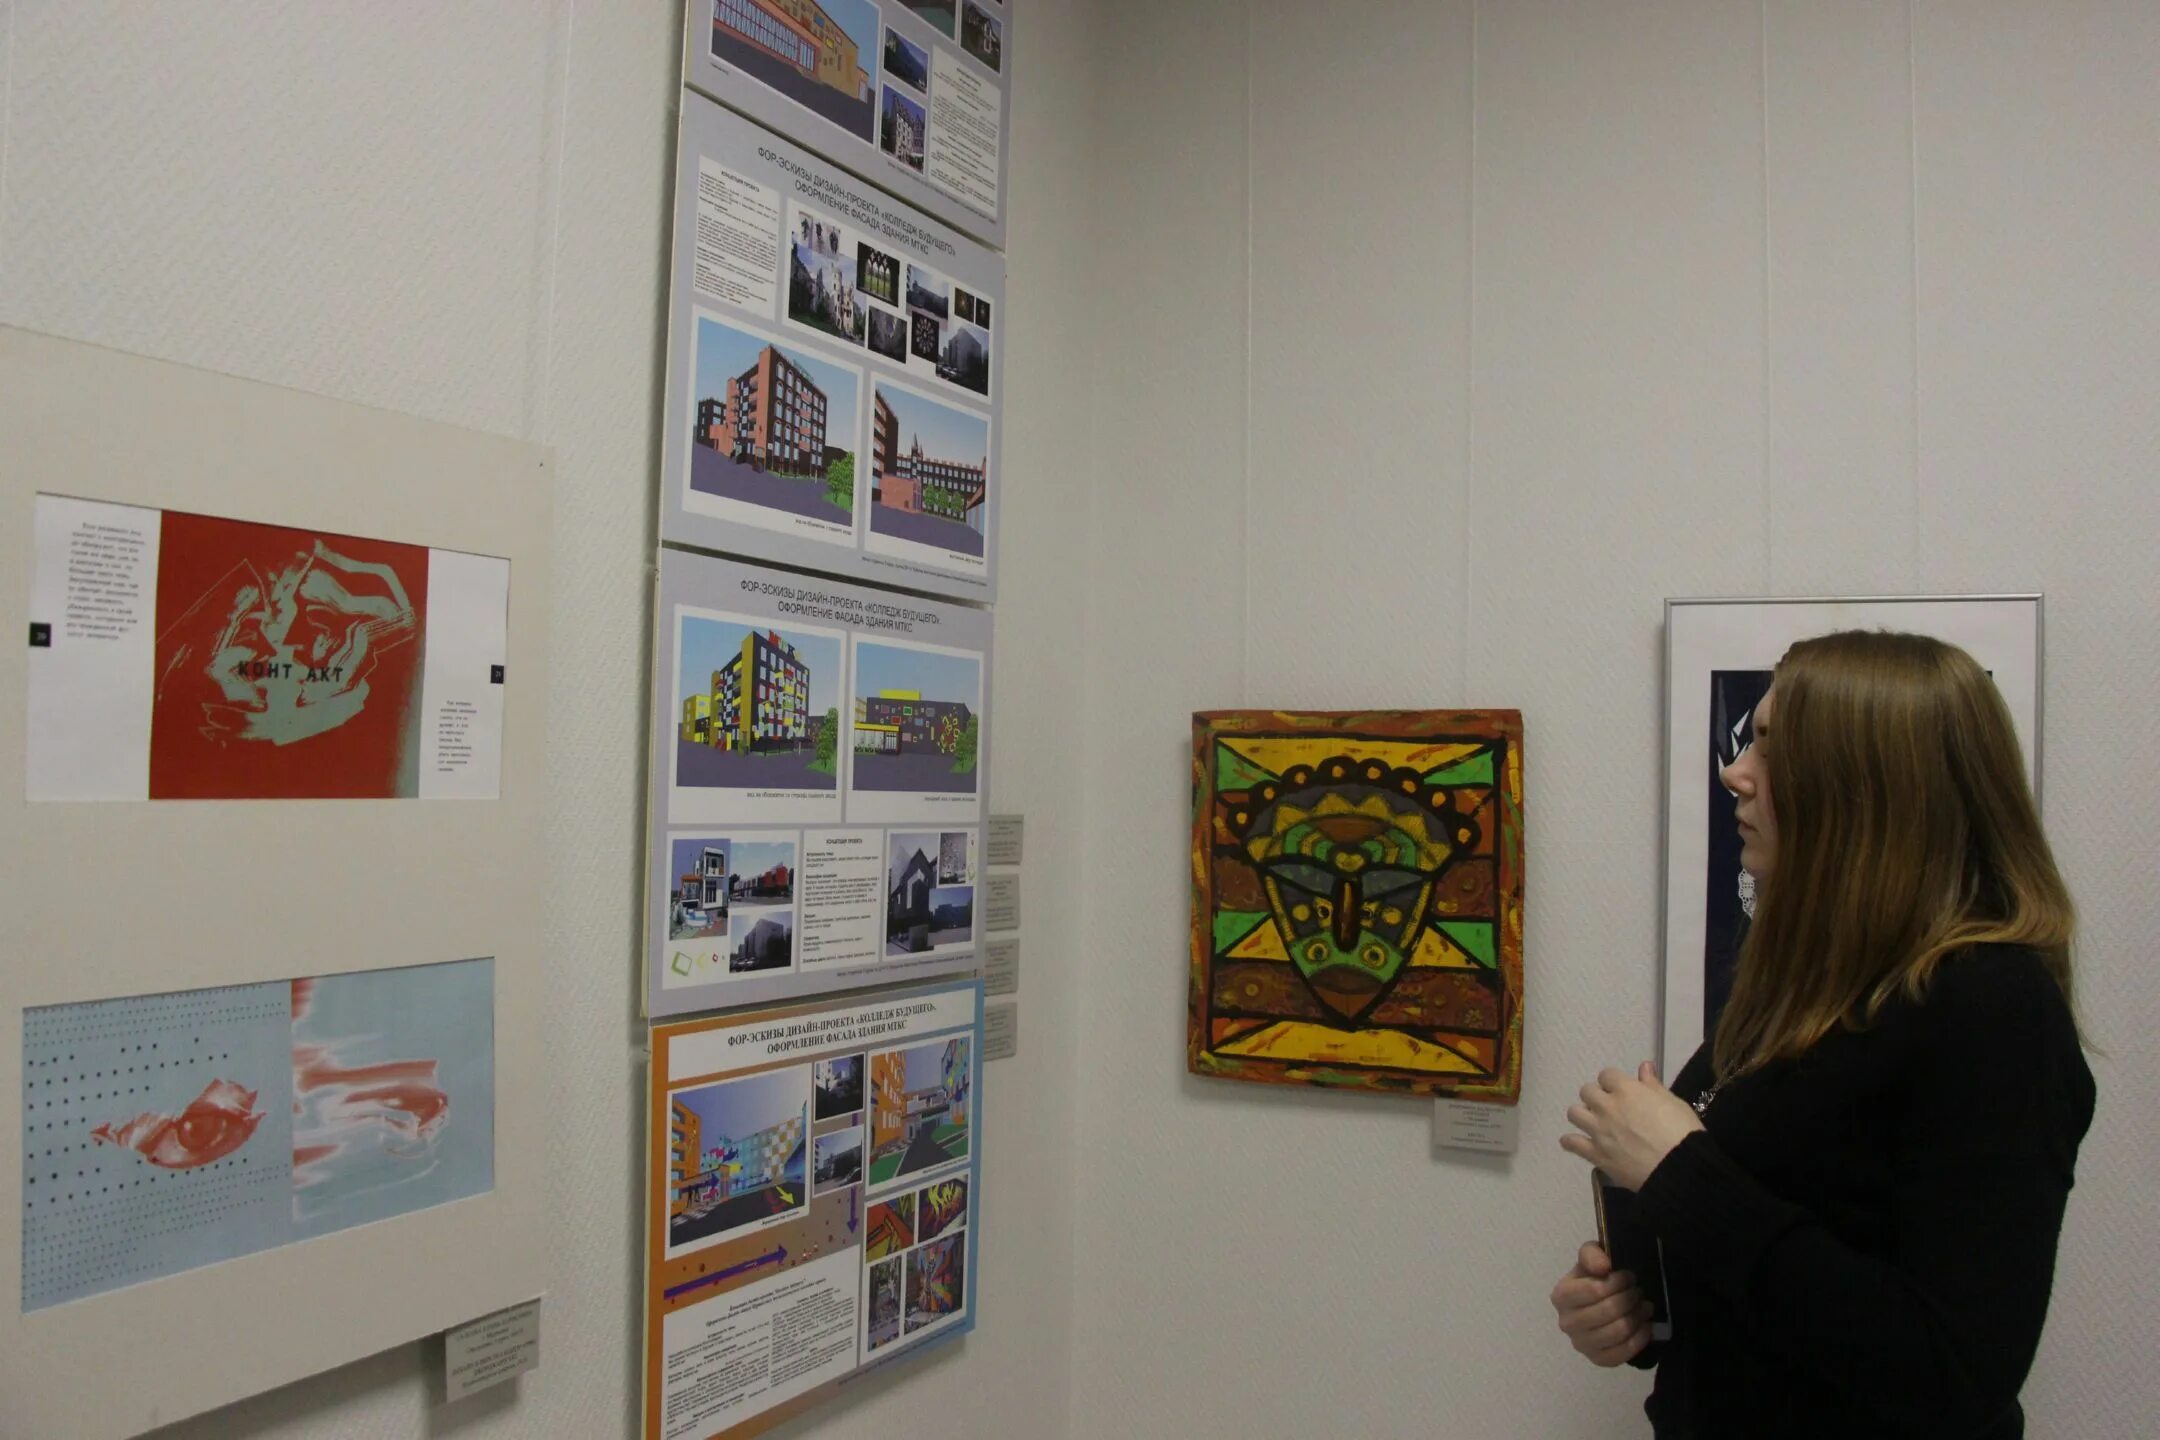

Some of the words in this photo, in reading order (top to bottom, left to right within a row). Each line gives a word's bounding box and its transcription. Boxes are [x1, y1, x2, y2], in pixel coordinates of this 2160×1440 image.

[758, 147, 813, 181] ФОР-ЭСКИЗЫ
[813, 175, 879, 215] ДИЗАЙН-ПРОЕКТА
[795, 179, 850, 216] ОФОРМЛЕНИЕ
[851, 208, 880, 231] ФАСАДА
[882, 223, 910, 246] ЗДАНИЯ
[911, 238, 929, 255] МТКС
[740, 580, 795, 599] ФОР-ЭСКИЗЫ
[796, 590, 863, 612] ДИЗАЙН-ПРОЕКТА
[778, 600, 833, 620] ОФОРМЛЕНИЕ
[835, 611, 864, 625] ФАСАДА
[865, 616, 893, 630] ЗДАНИЯ
[894, 621, 913, 633] МТКС
[238, 660, 292, 679] КОНТ
[306, 667, 343, 682] АКТ
[727, 1027, 784, 1046] ФОР-ЭСКИЗЫ
[785, 1017, 855, 1037] ДИЗАЙН-ПРОЕКТА
[767, 1033, 824, 1054] ОФОРМЛЕНИЕ
[826, 1029, 856, 1042] ФАСАДА
[858, 1023, 886, 1037] ЗДАНИЯ
[886, 1019, 907, 1032] МТКС
